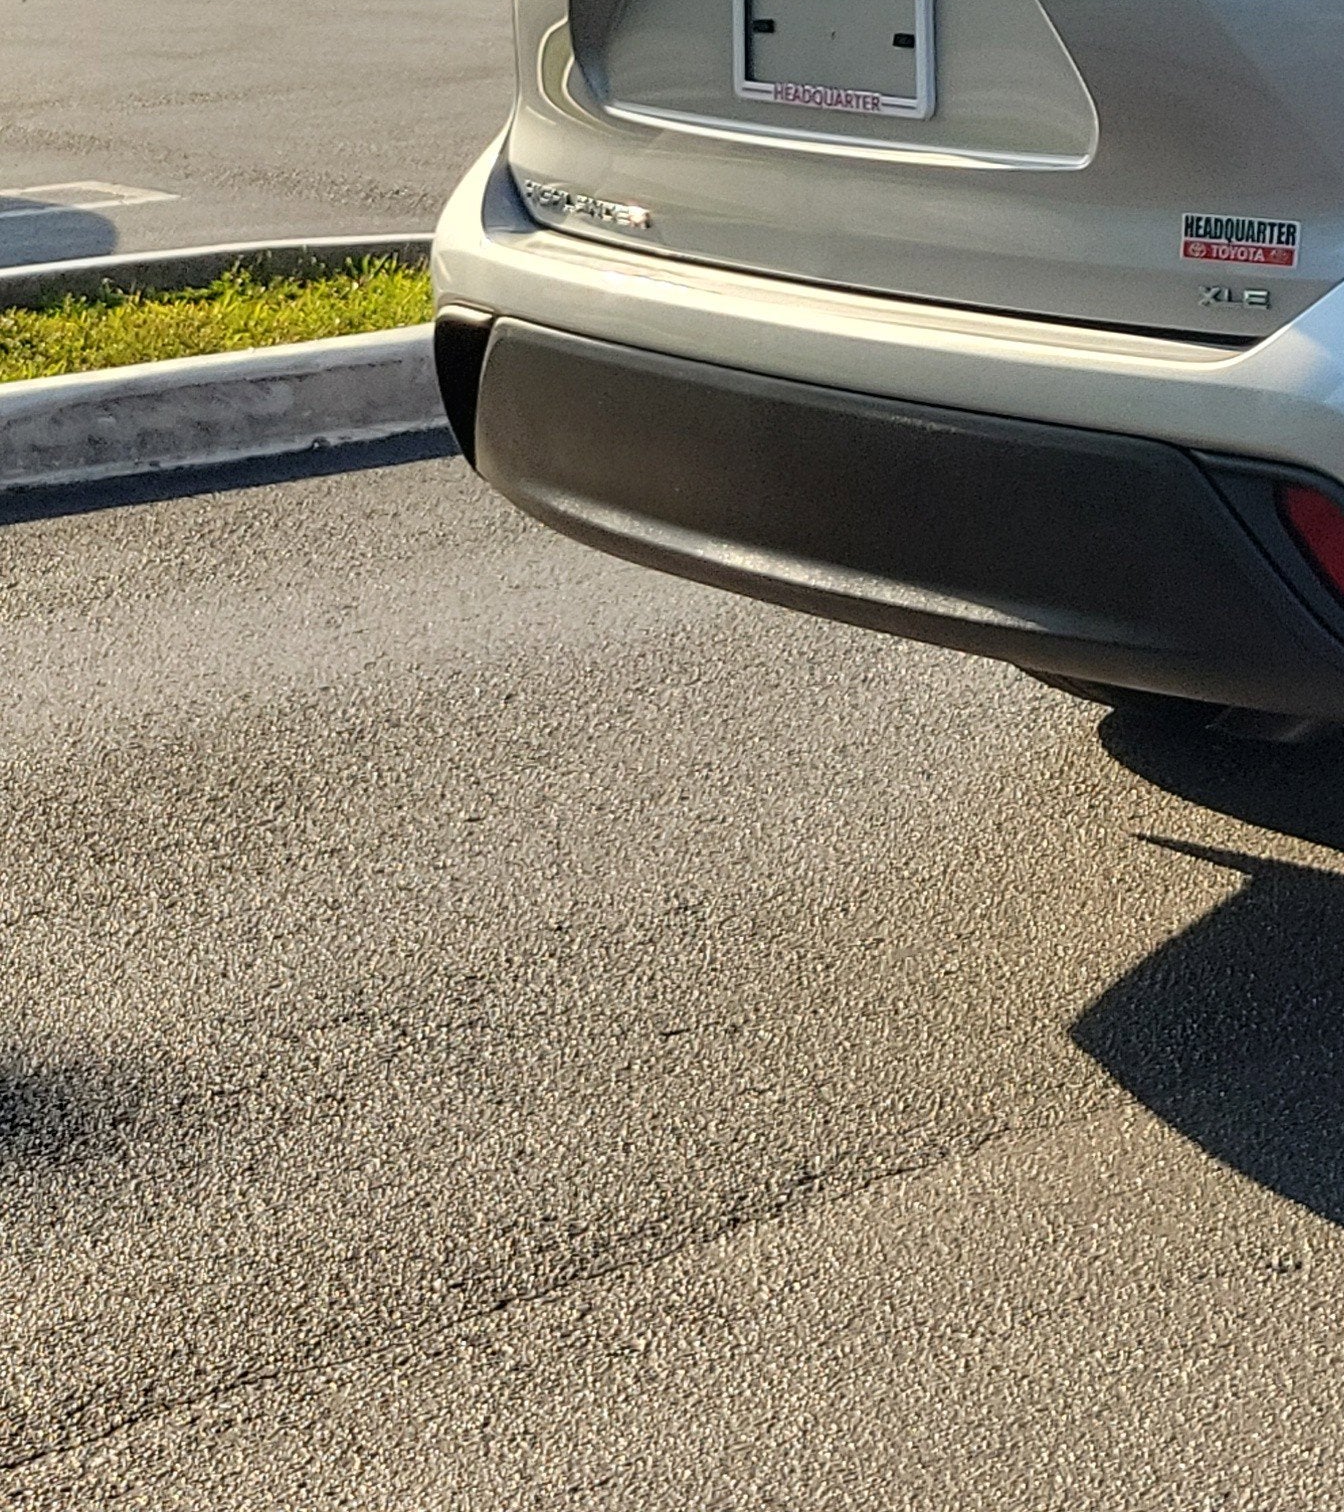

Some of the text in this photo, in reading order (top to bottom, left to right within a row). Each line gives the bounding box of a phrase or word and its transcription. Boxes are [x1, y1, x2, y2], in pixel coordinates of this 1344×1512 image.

[773, 83, 883, 112] HEADQUARTER
[1184, 215, 1297, 247] HEADQUARTER
[1211, 245, 1265, 262] TOYOTA
[1199, 286, 1270, 309] XLE
